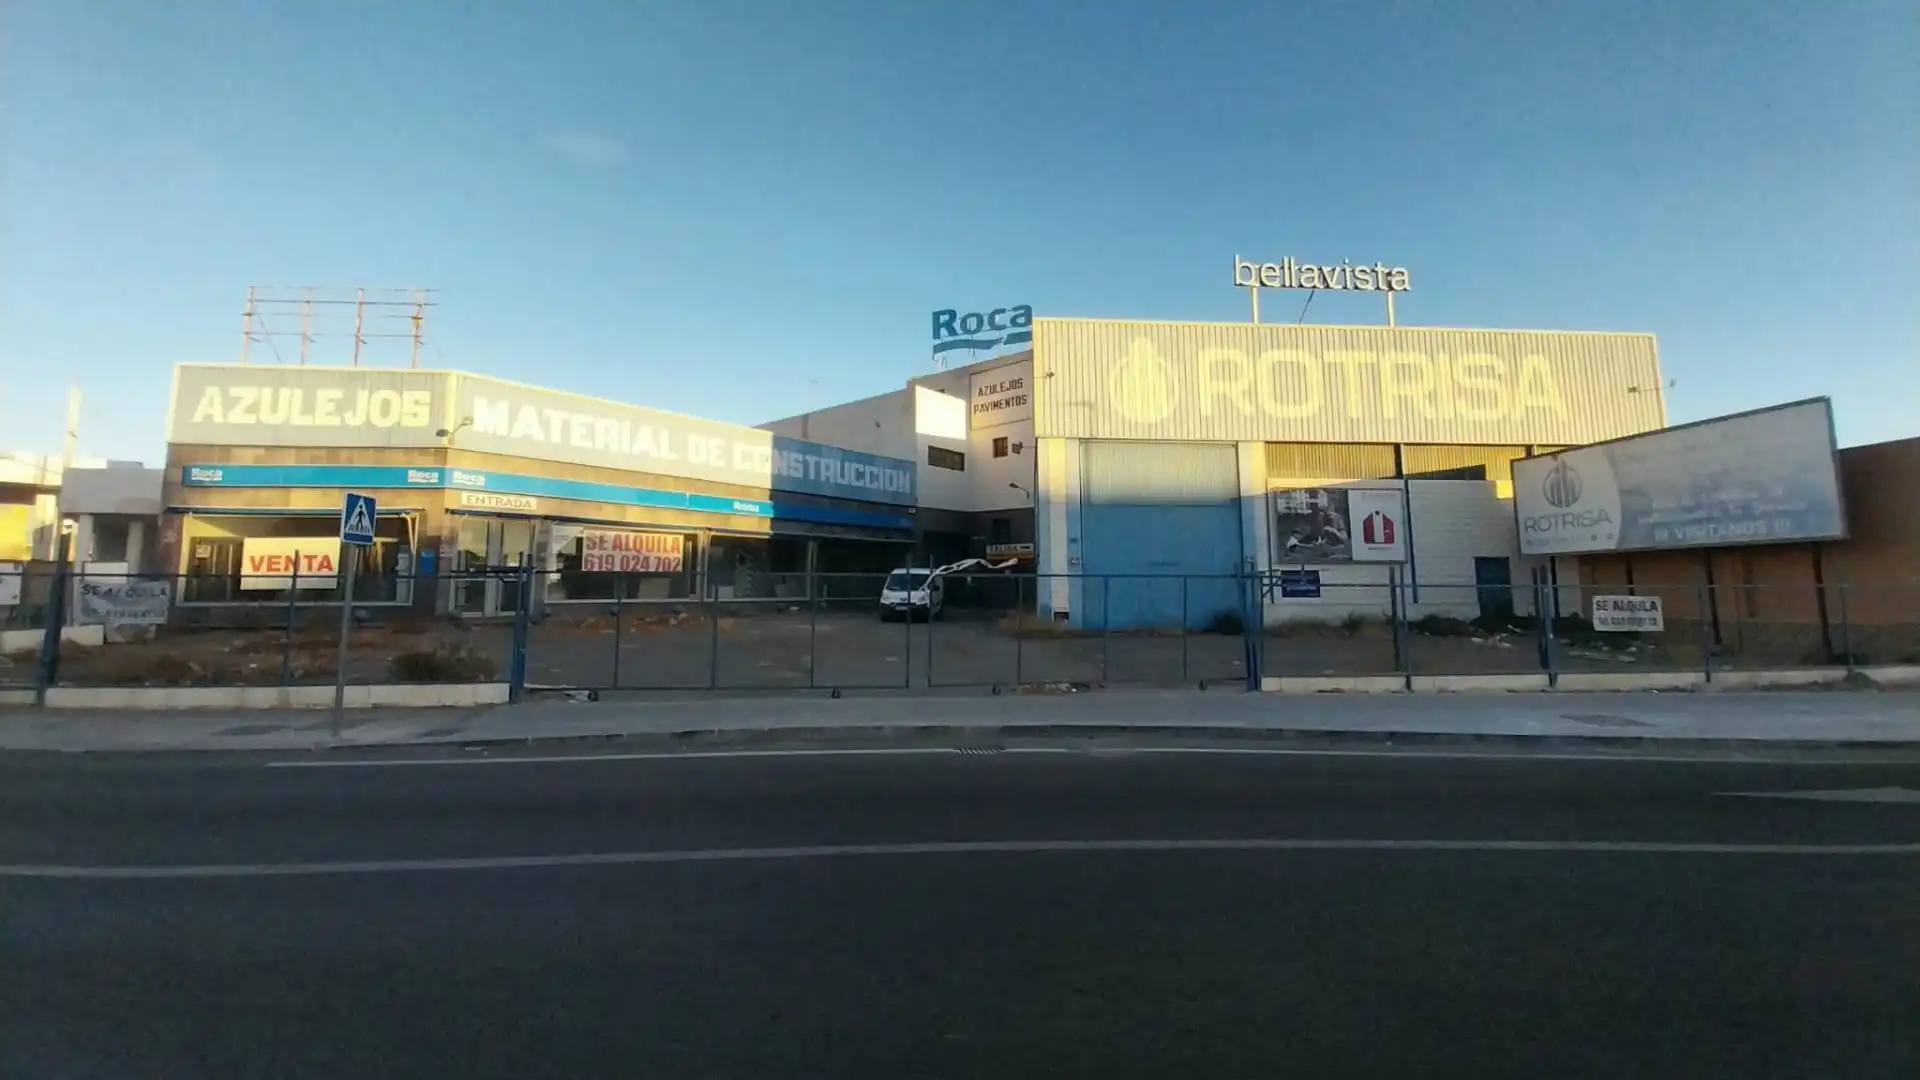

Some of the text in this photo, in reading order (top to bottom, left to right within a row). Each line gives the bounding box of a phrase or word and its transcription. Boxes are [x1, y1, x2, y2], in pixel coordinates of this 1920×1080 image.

[1233, 254, 1411, 291] bellavista
[932, 304, 1032, 339] Roca
[978, 378, 1023, 397] AZULEJOS
[1199, 348, 1568, 423] ROTRISA
[190, 386, 431, 427] AZULEJOS
[973, 394, 1028, 414] PAVIMENTOS
[473, 396, 910, 494] MATERIAL DE CONSTRUCCION
[191, 468, 223, 479] Roca
[408, 469, 439, 480] Roca
[452, 470, 485, 484] Roca
[466, 494, 533, 509] ENTRADA
[1524, 509, 1613, 533] ROTRISA
[586, 534, 681, 554] SE ALQUILA
[249, 554, 333, 572] VENTA
[584, 553, 681, 572] 619 024 702
[1595, 600, 1609, 611] SE
